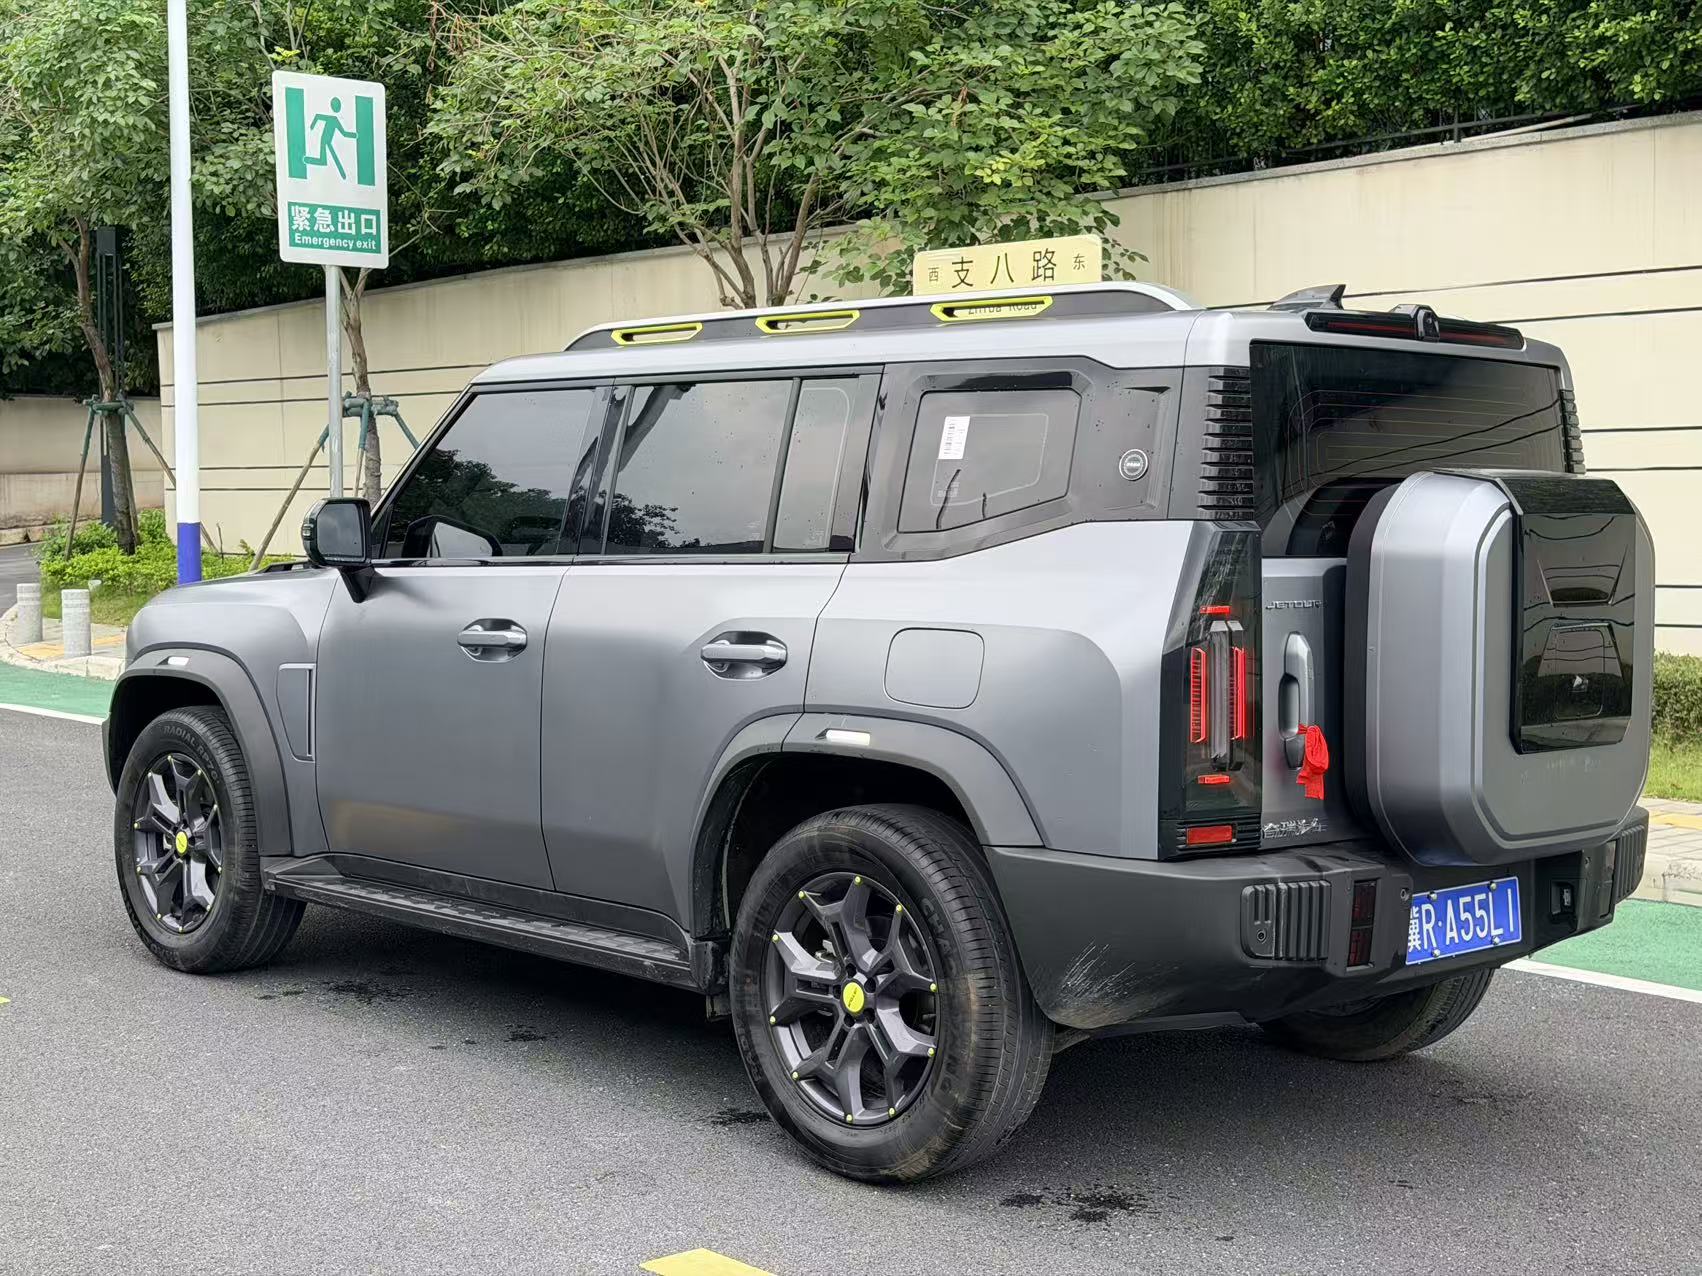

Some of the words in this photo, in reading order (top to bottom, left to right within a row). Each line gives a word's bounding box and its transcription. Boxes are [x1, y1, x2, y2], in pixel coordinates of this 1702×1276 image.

[291, 205, 377, 236] 紧急出口
[294, 232, 354, 249] Emergency
[356, 238, 376, 250] exit
[928, 266, 939, 282] 西
[951, 247, 1057, 289] 支八路
[1072, 253, 1086, 271] 东
[1265, 599, 1324, 609] JETOUR
